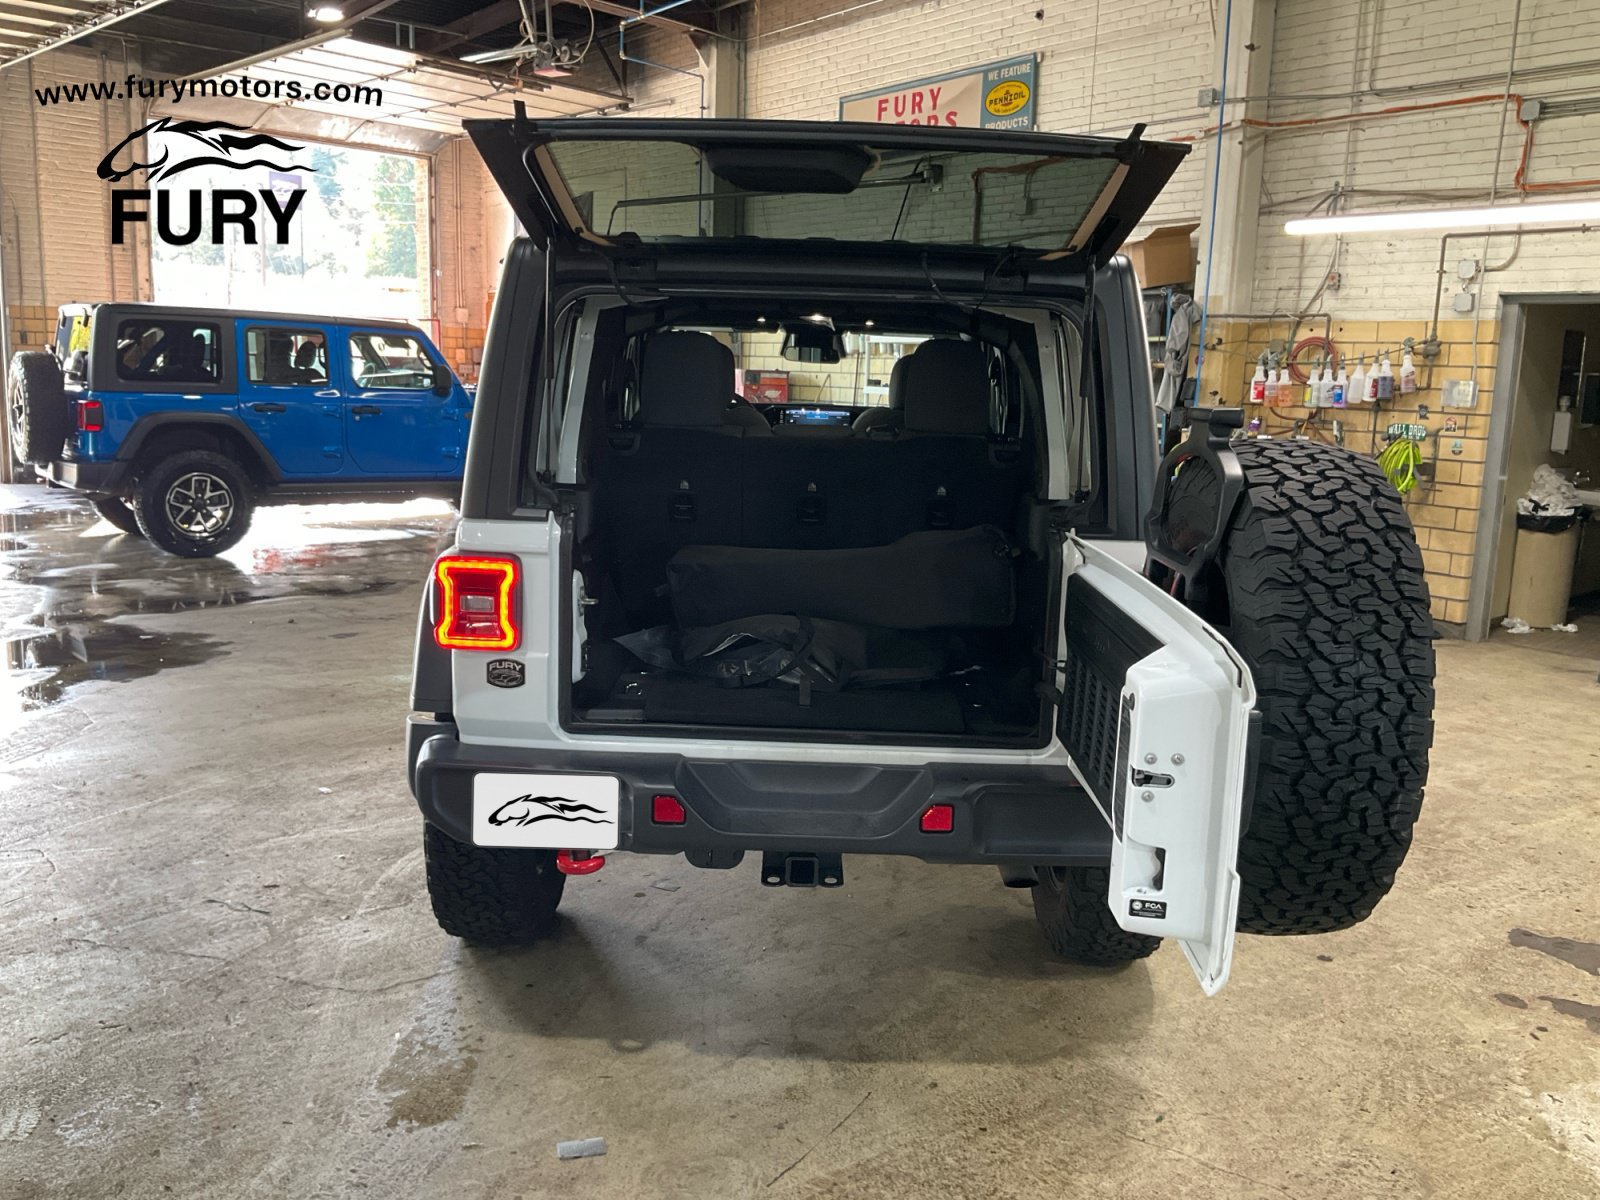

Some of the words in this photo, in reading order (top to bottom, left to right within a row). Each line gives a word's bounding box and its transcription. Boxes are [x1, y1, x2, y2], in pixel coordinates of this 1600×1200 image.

[988, 70, 999, 81] WE
[1001, 63, 1031, 78] FEATURE
[877, 87, 942, 121] FURY
[989, 91, 1026, 108] PENNZOIL
[489, 661, 521, 671] FURY
